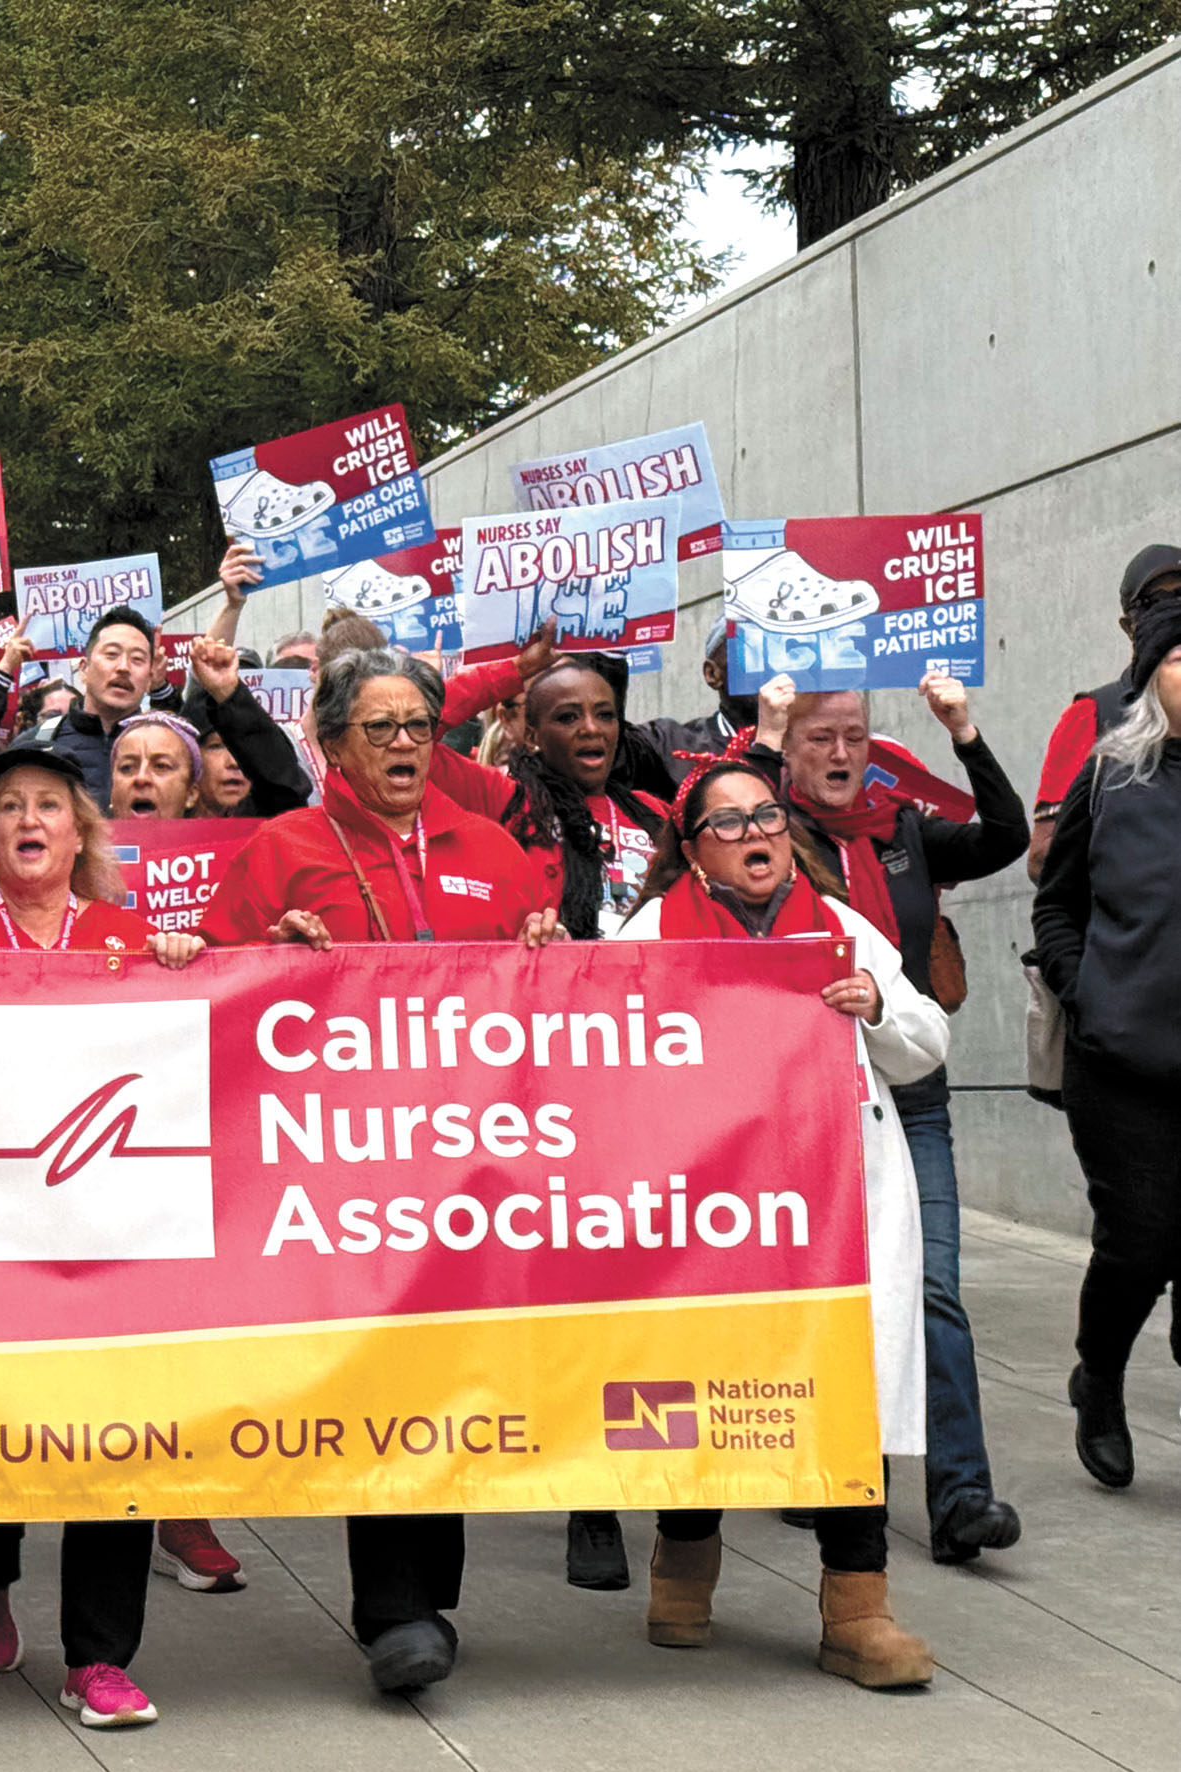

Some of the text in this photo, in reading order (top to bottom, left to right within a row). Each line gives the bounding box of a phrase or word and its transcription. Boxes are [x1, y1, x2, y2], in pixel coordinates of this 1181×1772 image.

[344, 413, 400, 448] WILL
[333, 431, 405, 476] CRUSH
[368, 451, 412, 486] ICE
[520, 457, 587, 486] NURSES SAY
[529, 444, 701, 510] ABOLISH
[342, 476, 416, 520] FOR OUR
[338, 493, 420, 540] PATIENTS!
[477, 521, 530, 545] NURSES
[536, 517, 562, 536] SAY
[907, 522, 975, 552] WILL
[474, 517, 665, 595] ABOLISH
[884, 547, 975, 581] CRUSH
[24, 569, 79, 586] NURSES SAY
[25, 568, 152, 616] ABOLISH
[925, 572, 976, 603] ICE
[884, 604, 976, 634] FOR OUR
[174, 641, 192, 654] WI
[874, 623, 977, 657] PATIENTS!
[166, 657, 192, 671] CRU
[244, 675, 263, 687] SAY
[147, 852, 215, 887] NOT
[147, 882, 220, 910] WELC
[256, 995, 704, 1073] California
[259, 1093, 577, 1164] Nurses
[261, 1174, 810, 1256] Association
[707, 1378, 814, 1400] National
[709, 1404, 796, 1425] Nurses
[0, 1421, 194, 1464] UNION.
[231, 1418, 345, 1459] OUR
[363, 1414, 541, 1457] VOICE.
[710, 1429, 795, 1450] United
